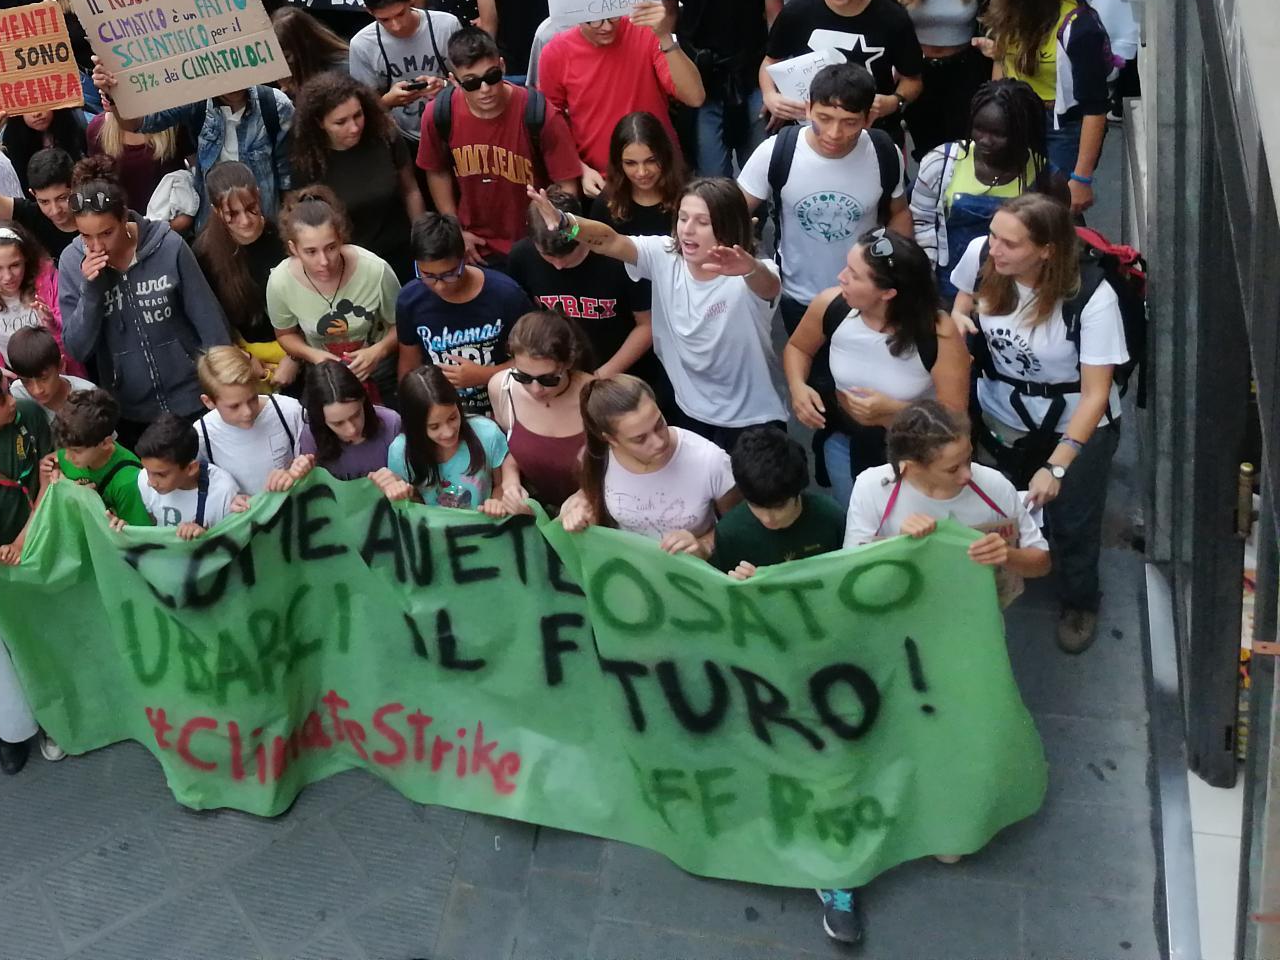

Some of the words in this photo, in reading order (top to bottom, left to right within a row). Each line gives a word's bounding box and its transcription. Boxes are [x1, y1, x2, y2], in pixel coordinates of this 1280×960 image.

[98, 8, 167, 43] CLIMATICO
[182, 12, 197, 23] un
[14, 41, 70, 70] SONO
[112, 24, 209, 68] SCIENTIFICO
[210, 26, 228, 45] per
[129, 73, 160, 93] 97%
[164, 68, 180, 84] dei
[536, 295, 617, 320] YREX
[590, 557, 925, 652] OSATO
[405, 608, 486, 672] IL
